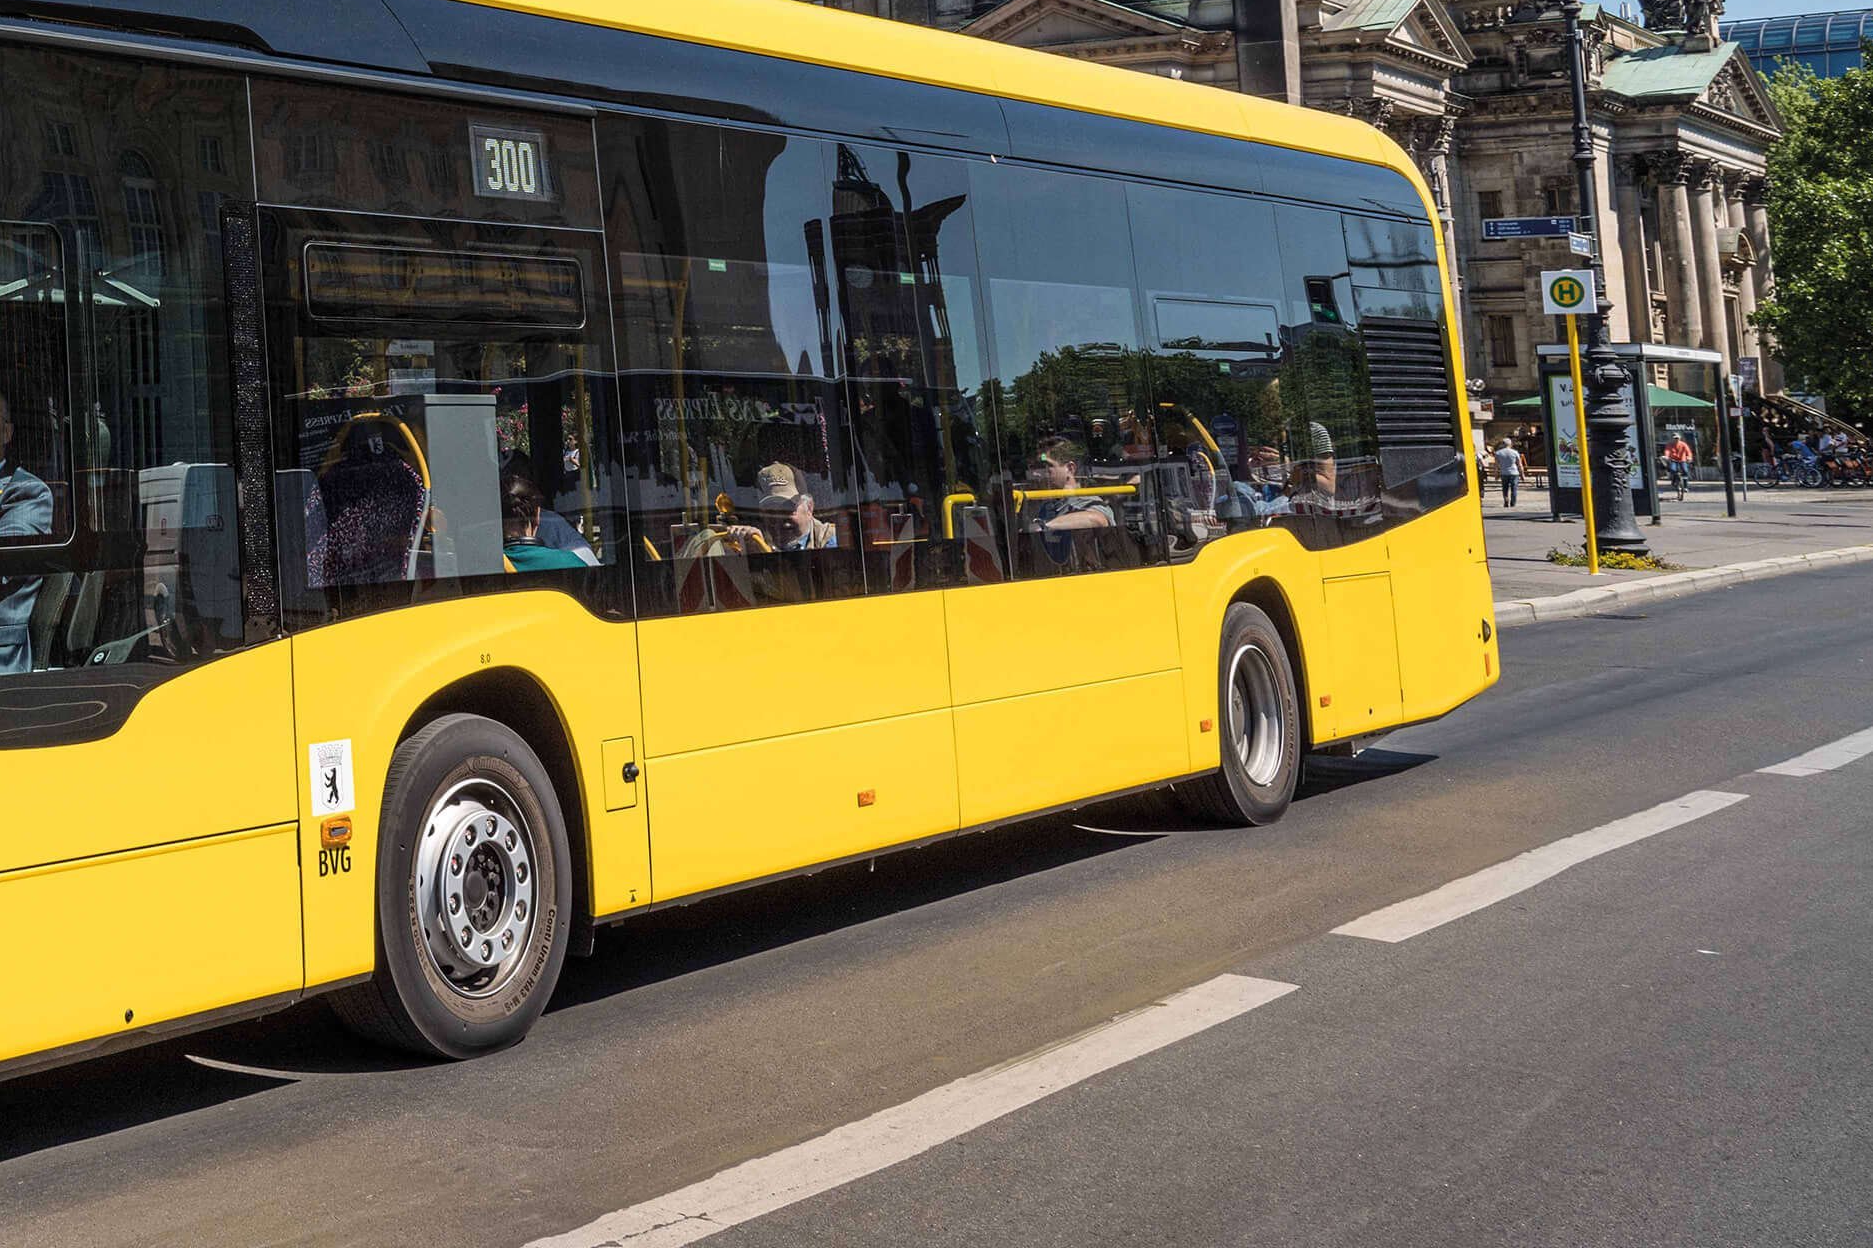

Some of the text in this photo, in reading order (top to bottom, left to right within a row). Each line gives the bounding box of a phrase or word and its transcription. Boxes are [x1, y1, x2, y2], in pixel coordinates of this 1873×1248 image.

[485, 138, 536, 194] 300
[1559, 284, 1575, 300] H
[319, 846, 351, 877] BVG
[544, 909, 556, 942] Conti
[531, 945, 549, 977] Urban
